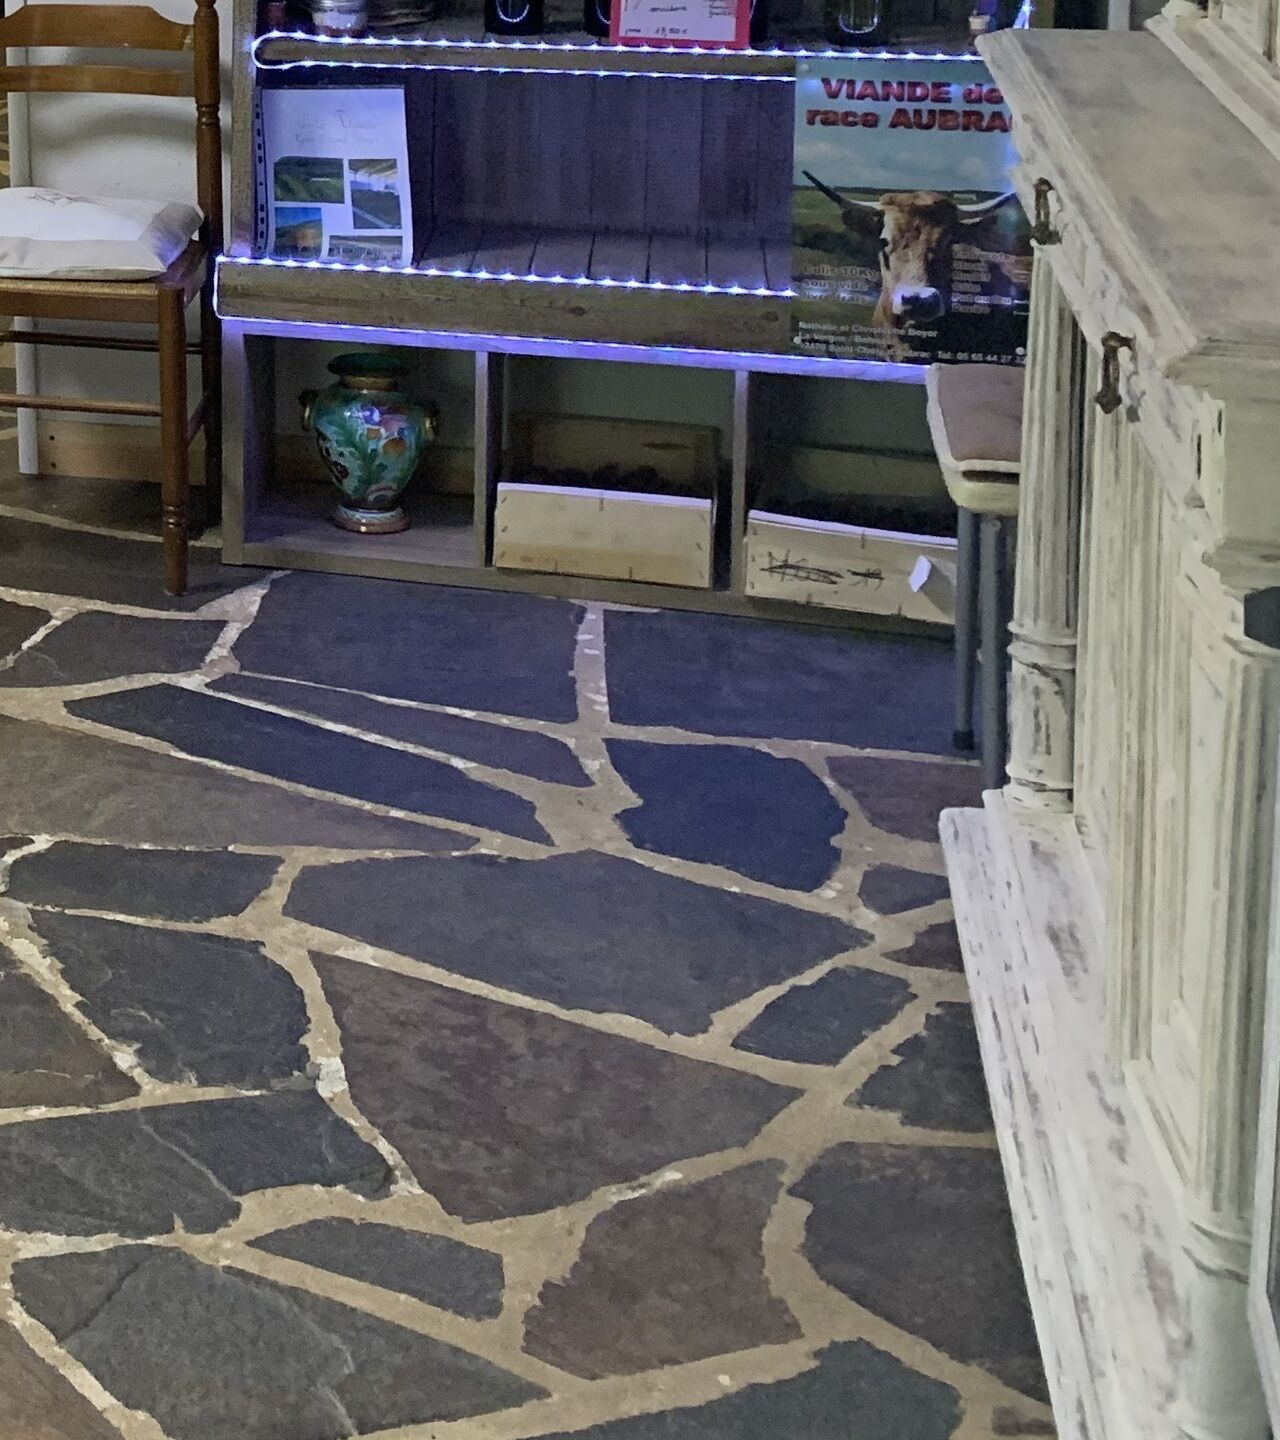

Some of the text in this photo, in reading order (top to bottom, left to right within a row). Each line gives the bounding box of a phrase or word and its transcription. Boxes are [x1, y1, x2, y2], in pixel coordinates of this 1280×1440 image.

[821, 77, 1004, 104] VIANDE de
[806, 108, 1012, 133] race AUBRA
